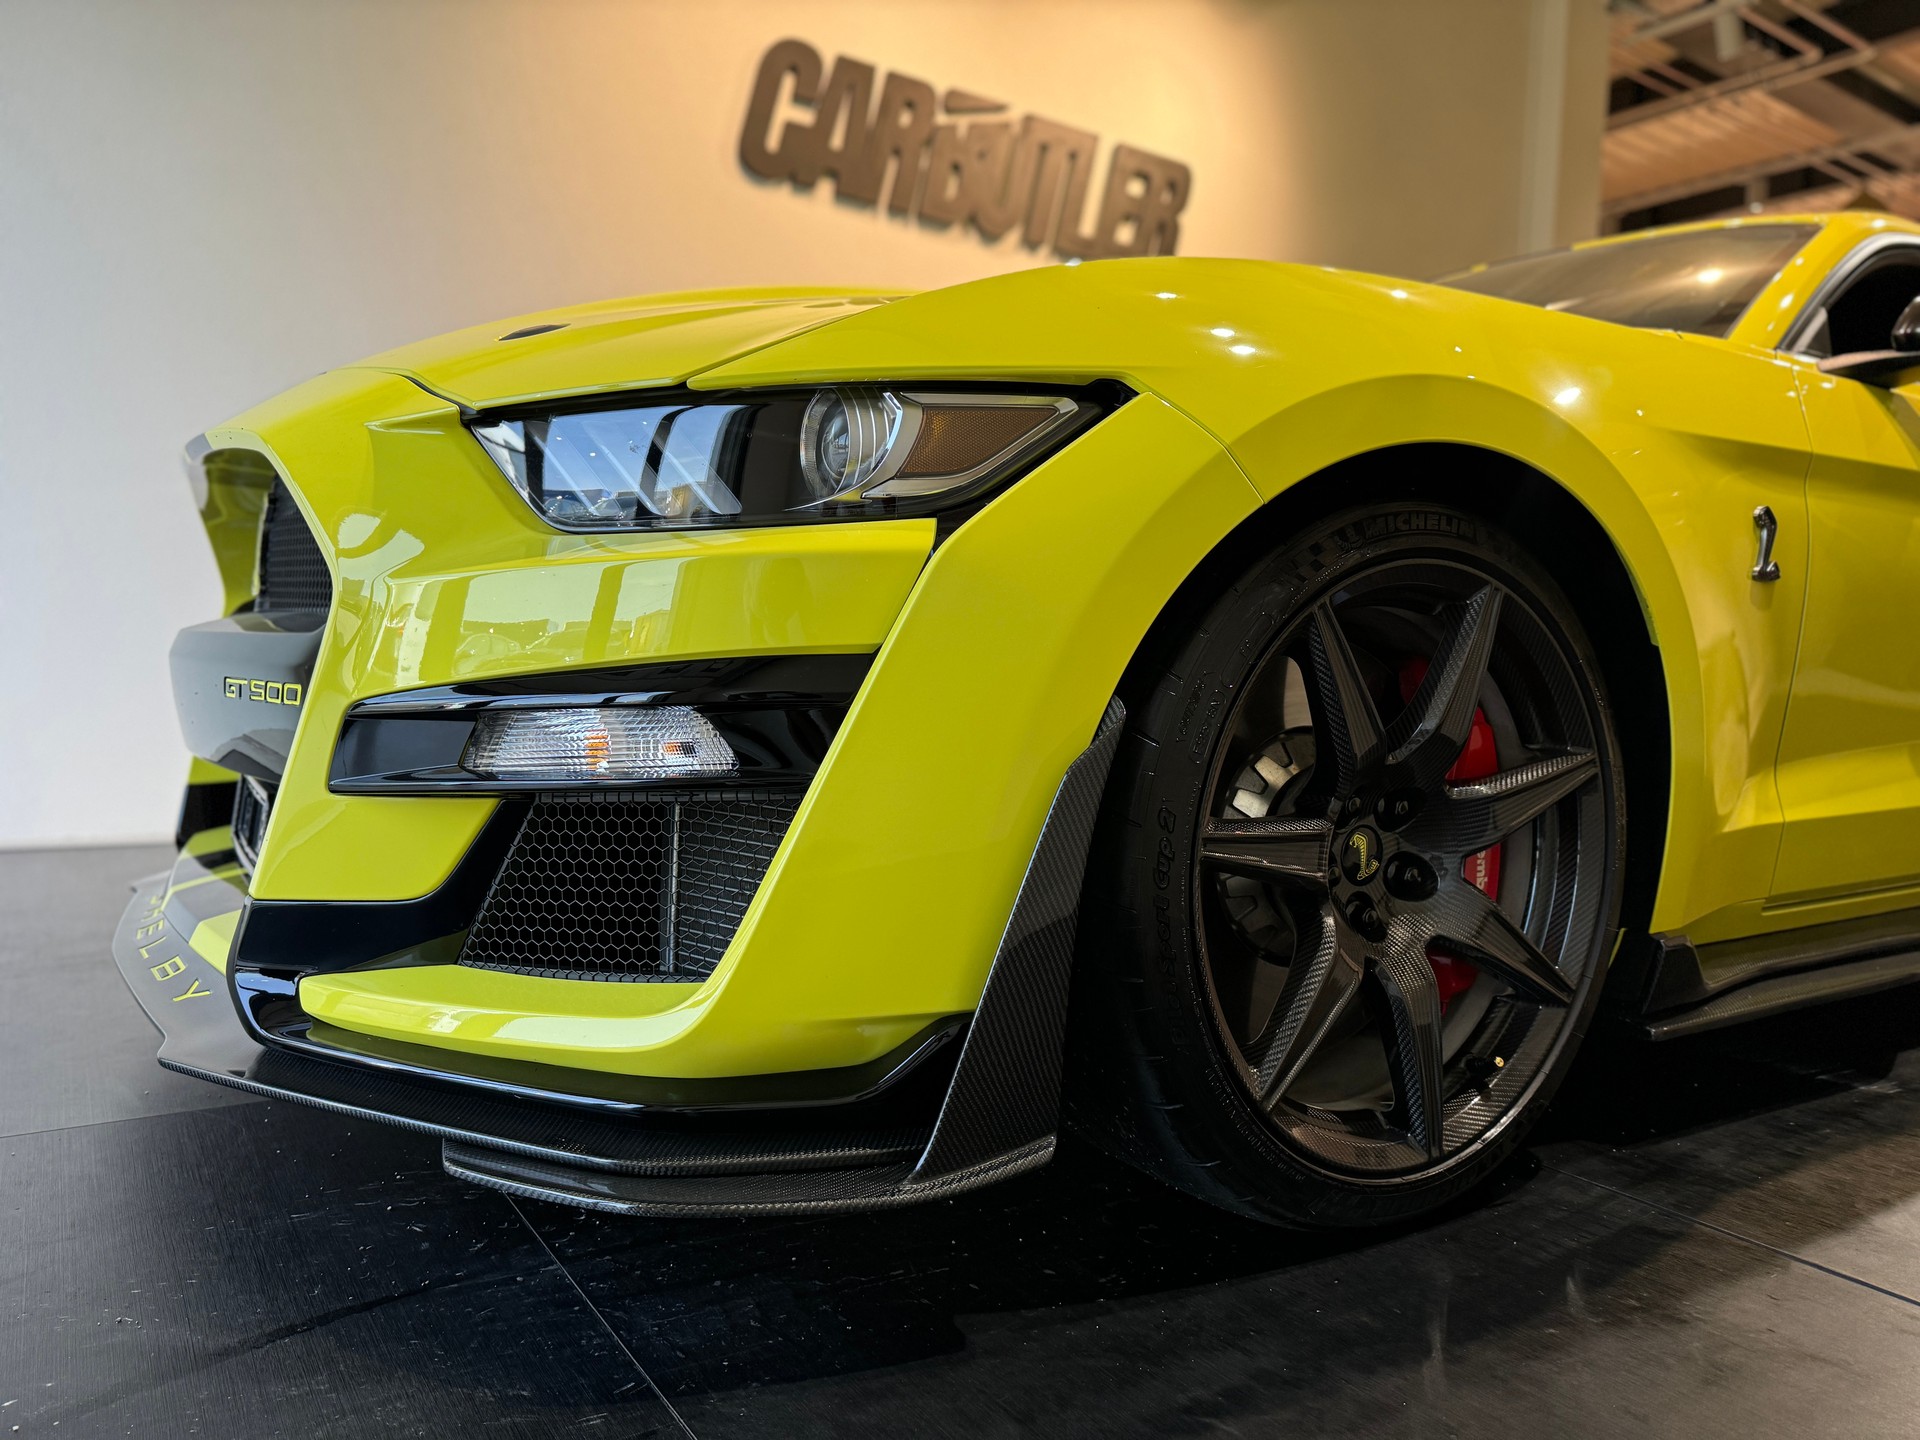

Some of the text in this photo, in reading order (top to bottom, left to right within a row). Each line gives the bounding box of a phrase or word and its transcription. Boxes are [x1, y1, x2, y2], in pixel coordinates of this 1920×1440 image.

[738, 38, 1192, 260] CARBUTLER
[1366, 512, 1476, 541] MICHELIN
[1476, 850, 1488, 890] emb
